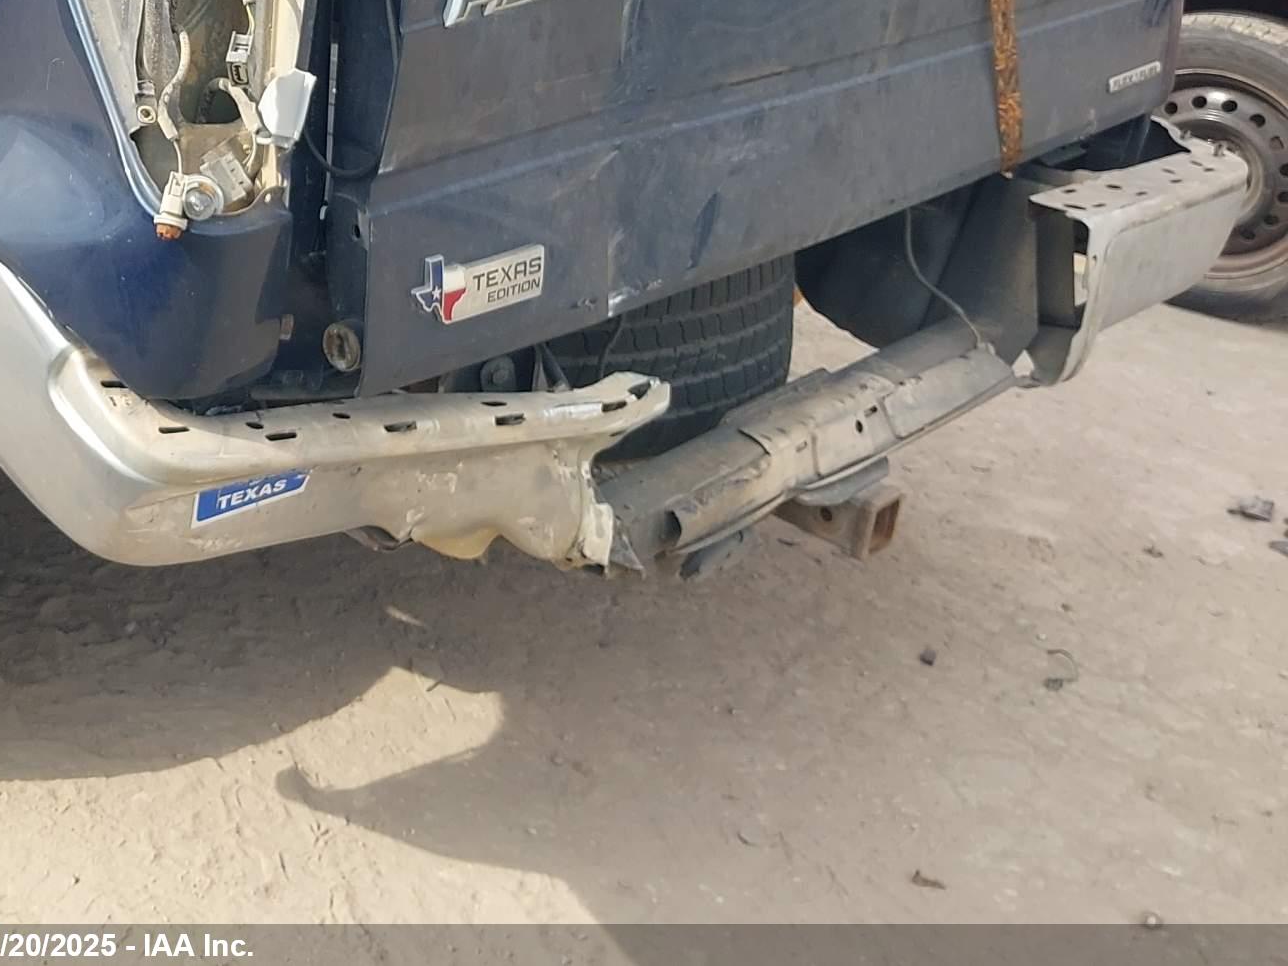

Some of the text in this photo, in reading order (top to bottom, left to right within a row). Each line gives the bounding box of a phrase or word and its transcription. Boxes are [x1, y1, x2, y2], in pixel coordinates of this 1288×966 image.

[473, 257, 542, 290] TEXAS
[487, 277, 541, 303] EDITION
[218, 479, 288, 509] TEXAS
